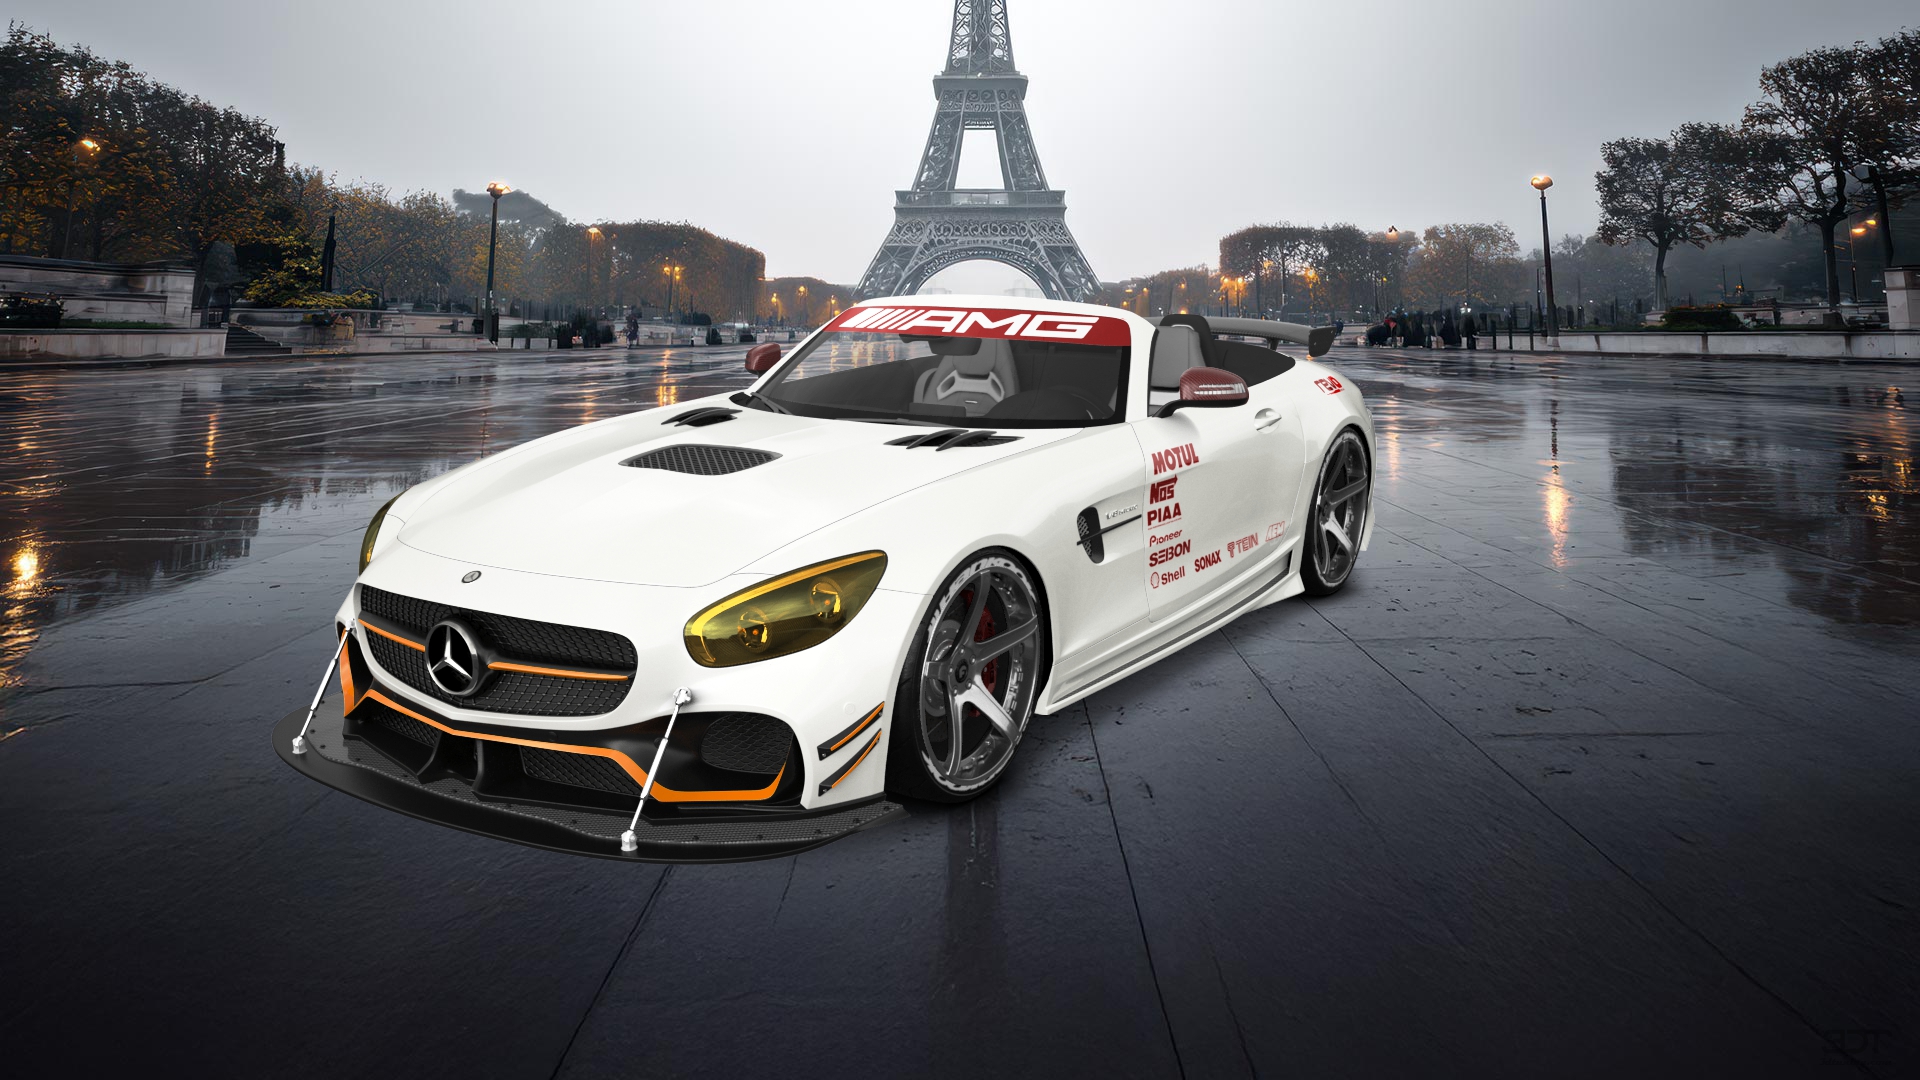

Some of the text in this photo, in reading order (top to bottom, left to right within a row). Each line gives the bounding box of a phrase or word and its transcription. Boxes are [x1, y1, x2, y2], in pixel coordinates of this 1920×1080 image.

[1151, 442, 1200, 475] MOTUL
[1149, 479, 1177, 504] NOS
[1147, 502, 1182, 526] PIAA
[1149, 529, 1183, 547] Pioneer
[1235, 532, 1259, 554] TEIN
[1265, 521, 1286, 542] AEM
[1149, 539, 1191, 567] SEBON
[1194, 549, 1222, 573] SONAX
[1161, 565, 1186, 585] Shell
